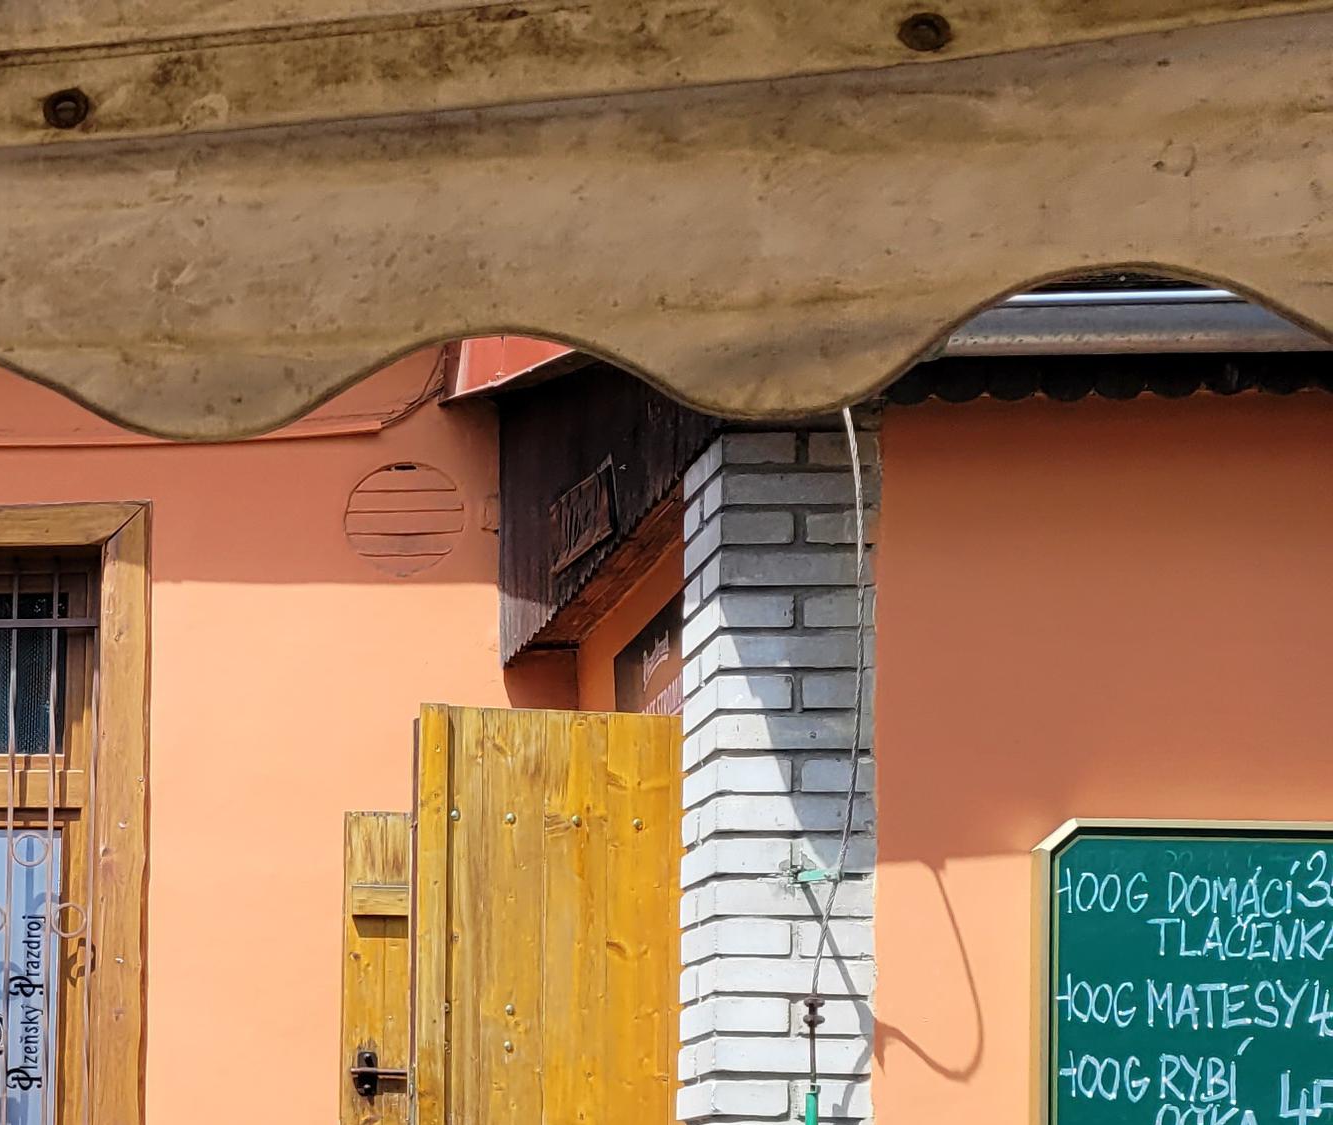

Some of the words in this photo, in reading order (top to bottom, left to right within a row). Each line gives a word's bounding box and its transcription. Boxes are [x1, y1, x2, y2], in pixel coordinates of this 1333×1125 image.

[1056, 868, 1149, 913] 100G
[1167, 861, 1301, 918] DOMÁCÍ
[1296, 849, 1333, 908] 3
[9, 914, 47, 998] Prazdroj
[1055, 972, 1137, 1028] 100G
[1146, 978, 1310, 1031] MATESY
[5, 1004, 43, 1091] Plzeňský
[1059, 1050, 1151, 1103] 100G
[1159, 1036, 1254, 1105] RYBÍ
